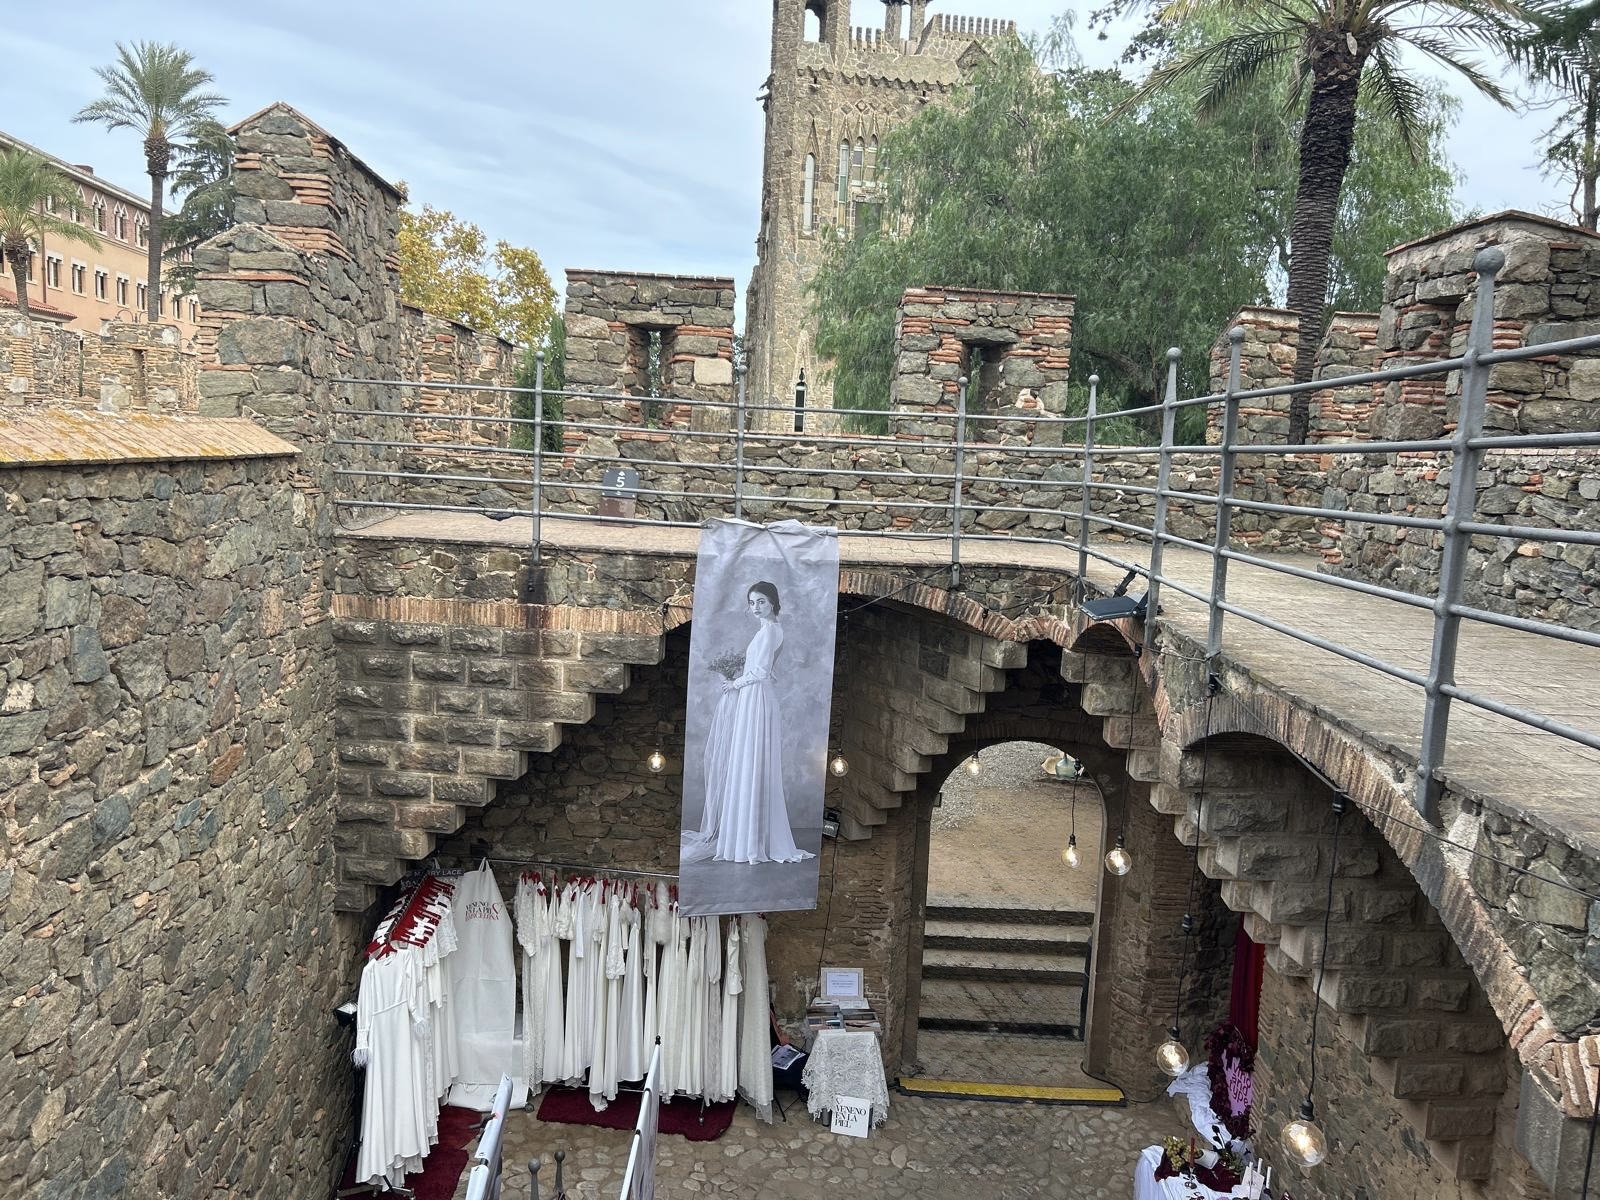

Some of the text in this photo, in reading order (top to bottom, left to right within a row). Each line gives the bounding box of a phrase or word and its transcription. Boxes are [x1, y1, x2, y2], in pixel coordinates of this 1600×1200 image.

[616, 476, 626, 488] 5
[835, 1104, 867, 1116] VENENO
[835, 1111, 857, 1122] EN LA
[834, 1118, 852, 1128] PIEL
